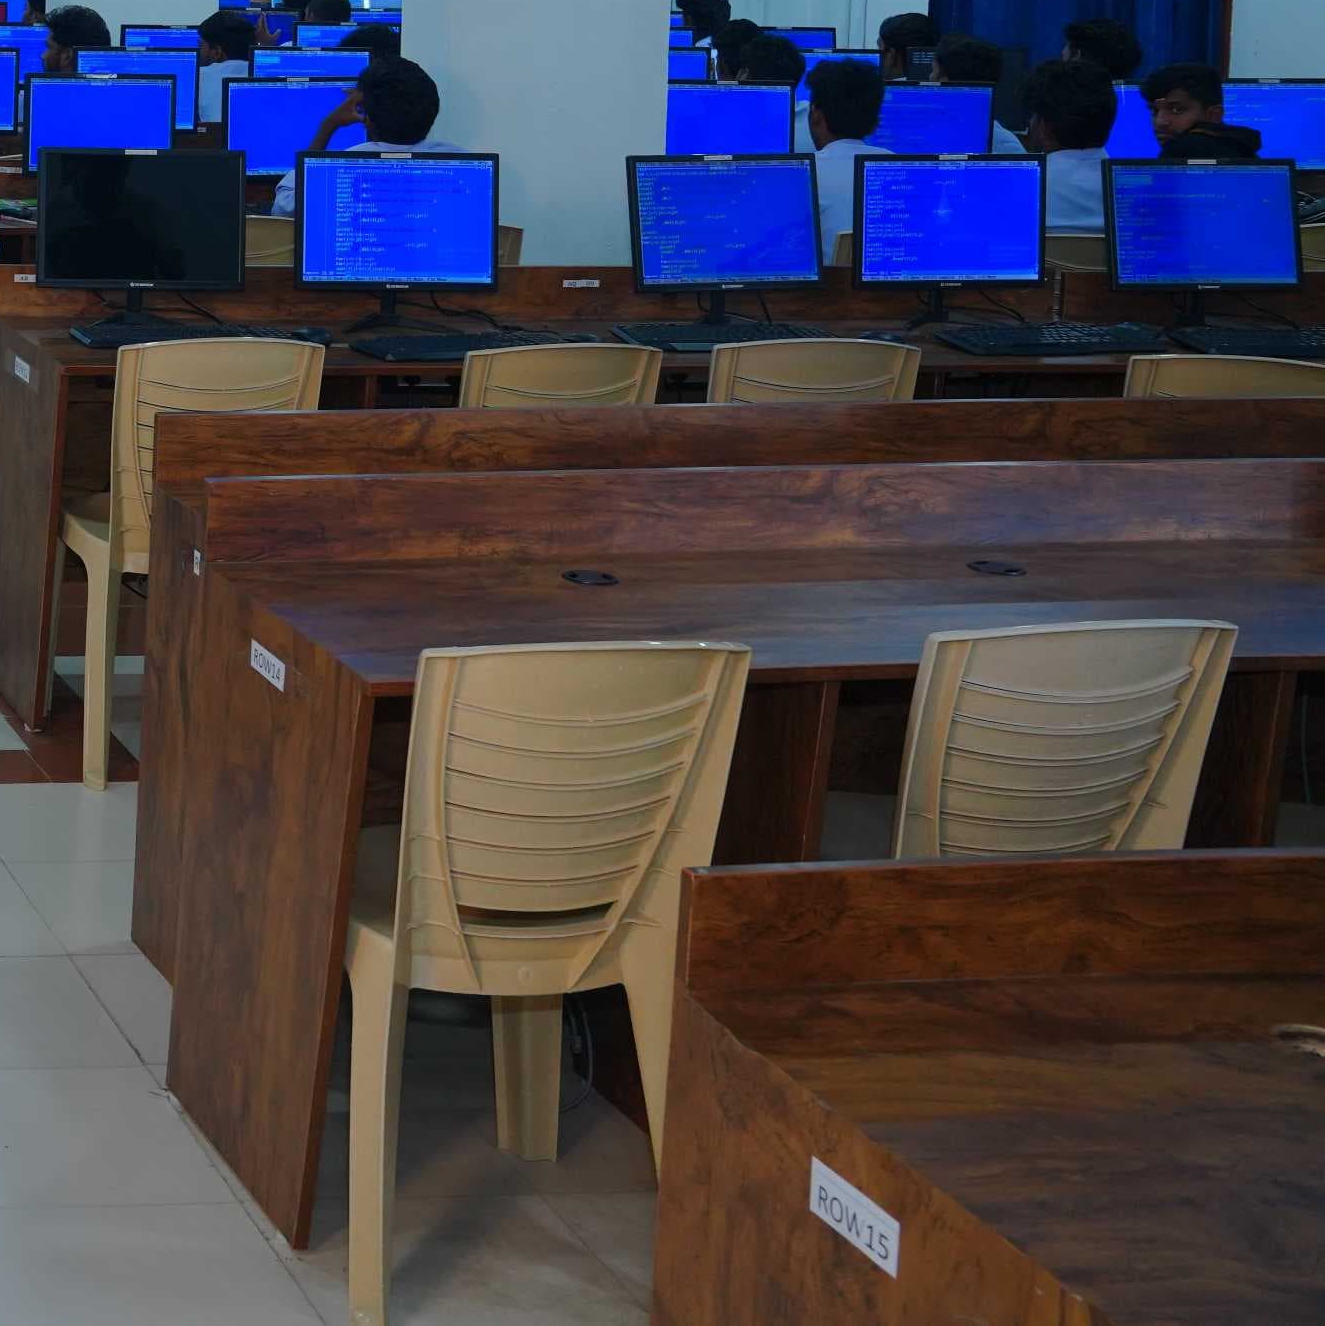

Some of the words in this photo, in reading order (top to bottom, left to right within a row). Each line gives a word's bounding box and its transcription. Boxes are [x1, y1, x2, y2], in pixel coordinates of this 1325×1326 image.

[254, 648, 271, 675] ROW
[818, 1185, 860, 1239] ROW
[866, 1224, 889, 1261] 15
